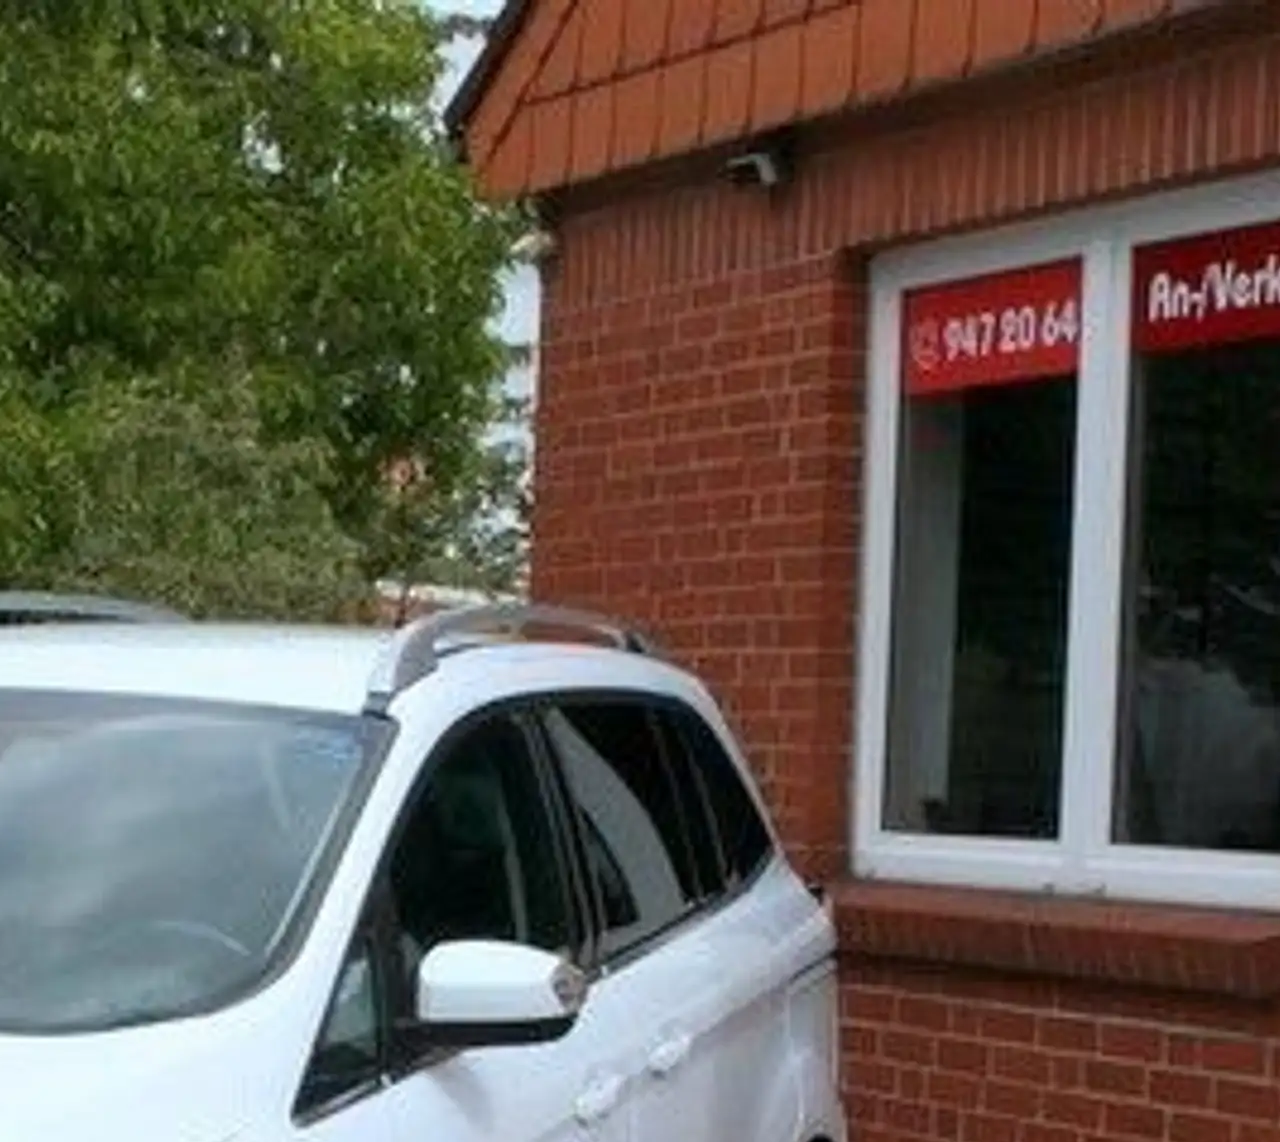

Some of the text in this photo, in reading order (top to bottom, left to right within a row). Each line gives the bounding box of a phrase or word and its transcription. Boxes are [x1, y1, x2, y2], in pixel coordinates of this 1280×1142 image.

[943, 300, 1077, 361] 947 20 64
